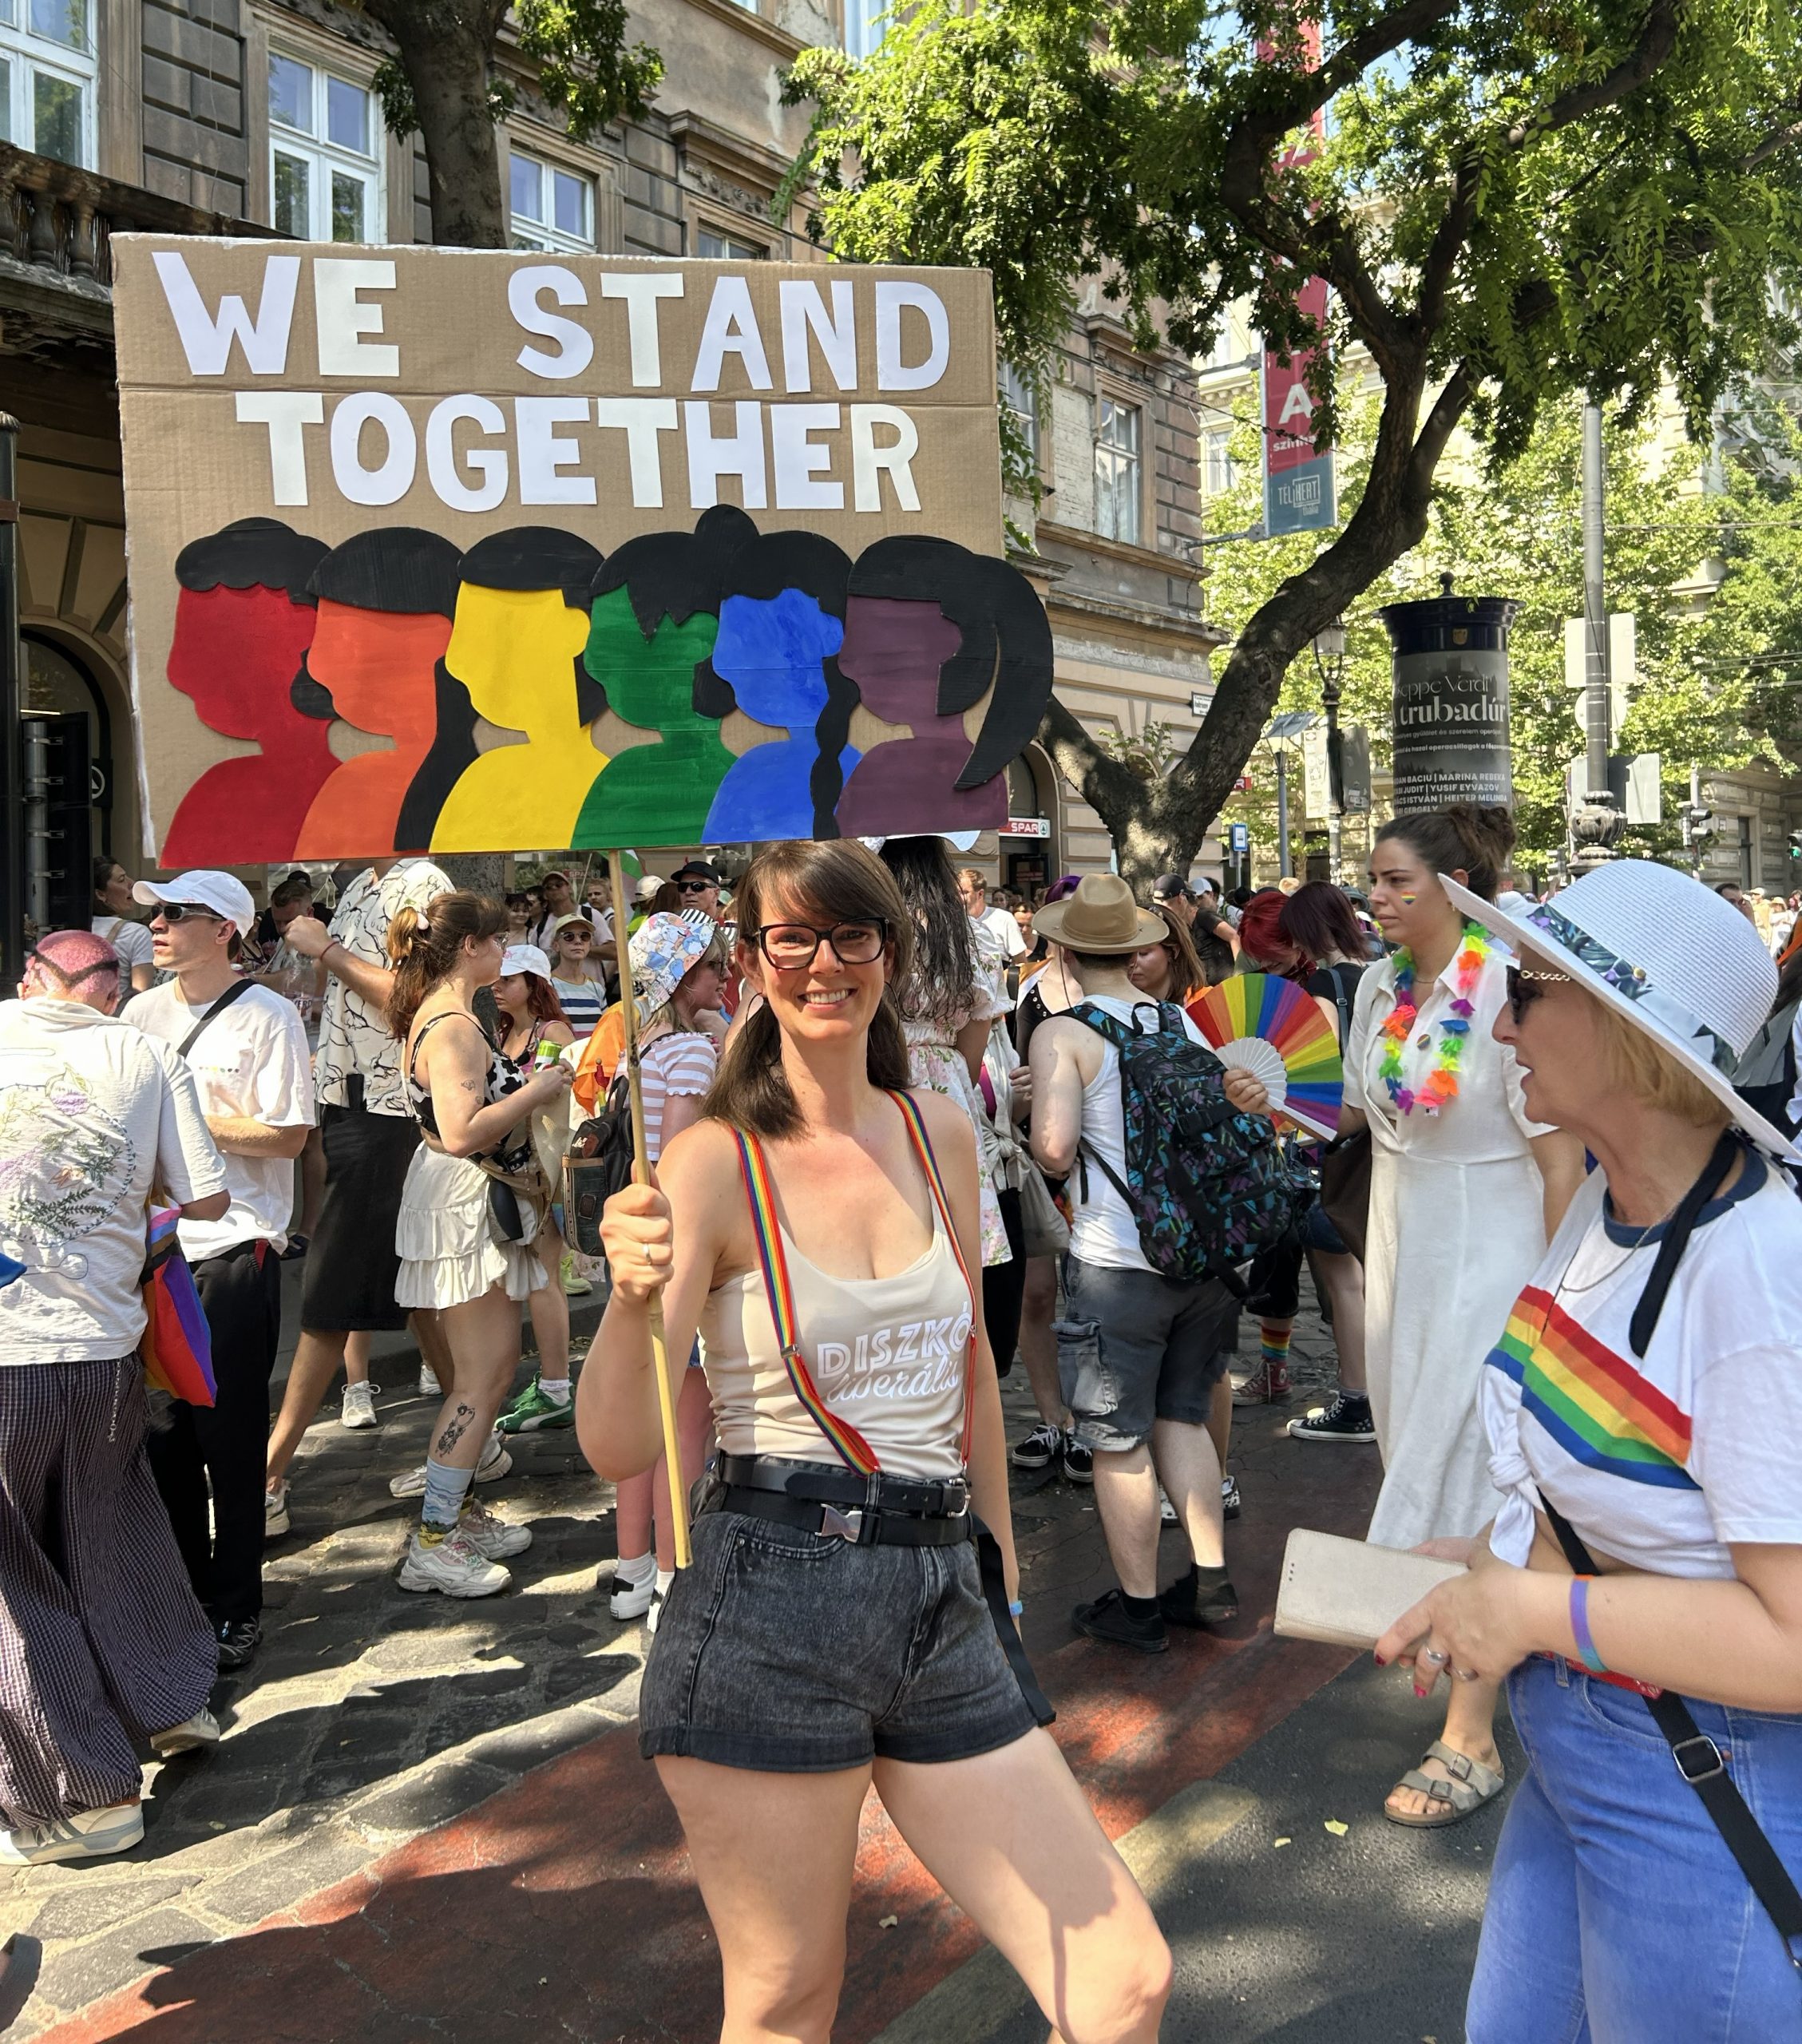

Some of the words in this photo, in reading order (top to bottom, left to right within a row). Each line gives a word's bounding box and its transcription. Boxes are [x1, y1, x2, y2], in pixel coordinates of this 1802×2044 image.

[152, 252, 401, 378] WE
[507, 264, 951, 394] STAND
[235, 390, 922, 513] TOGETHER
[1444, 674, 1489, 694] Verdi
[1400, 694, 1506, 727] trubadúr
[1404, 785, 1424, 794] JUDIT
[1430, 783, 1458, 793] YUSIF
[1439, 773, 1478, 782] MARINA
[1011, 822, 1039, 833] SPAR
[817, 1301, 972, 1380] DISZKÓ
